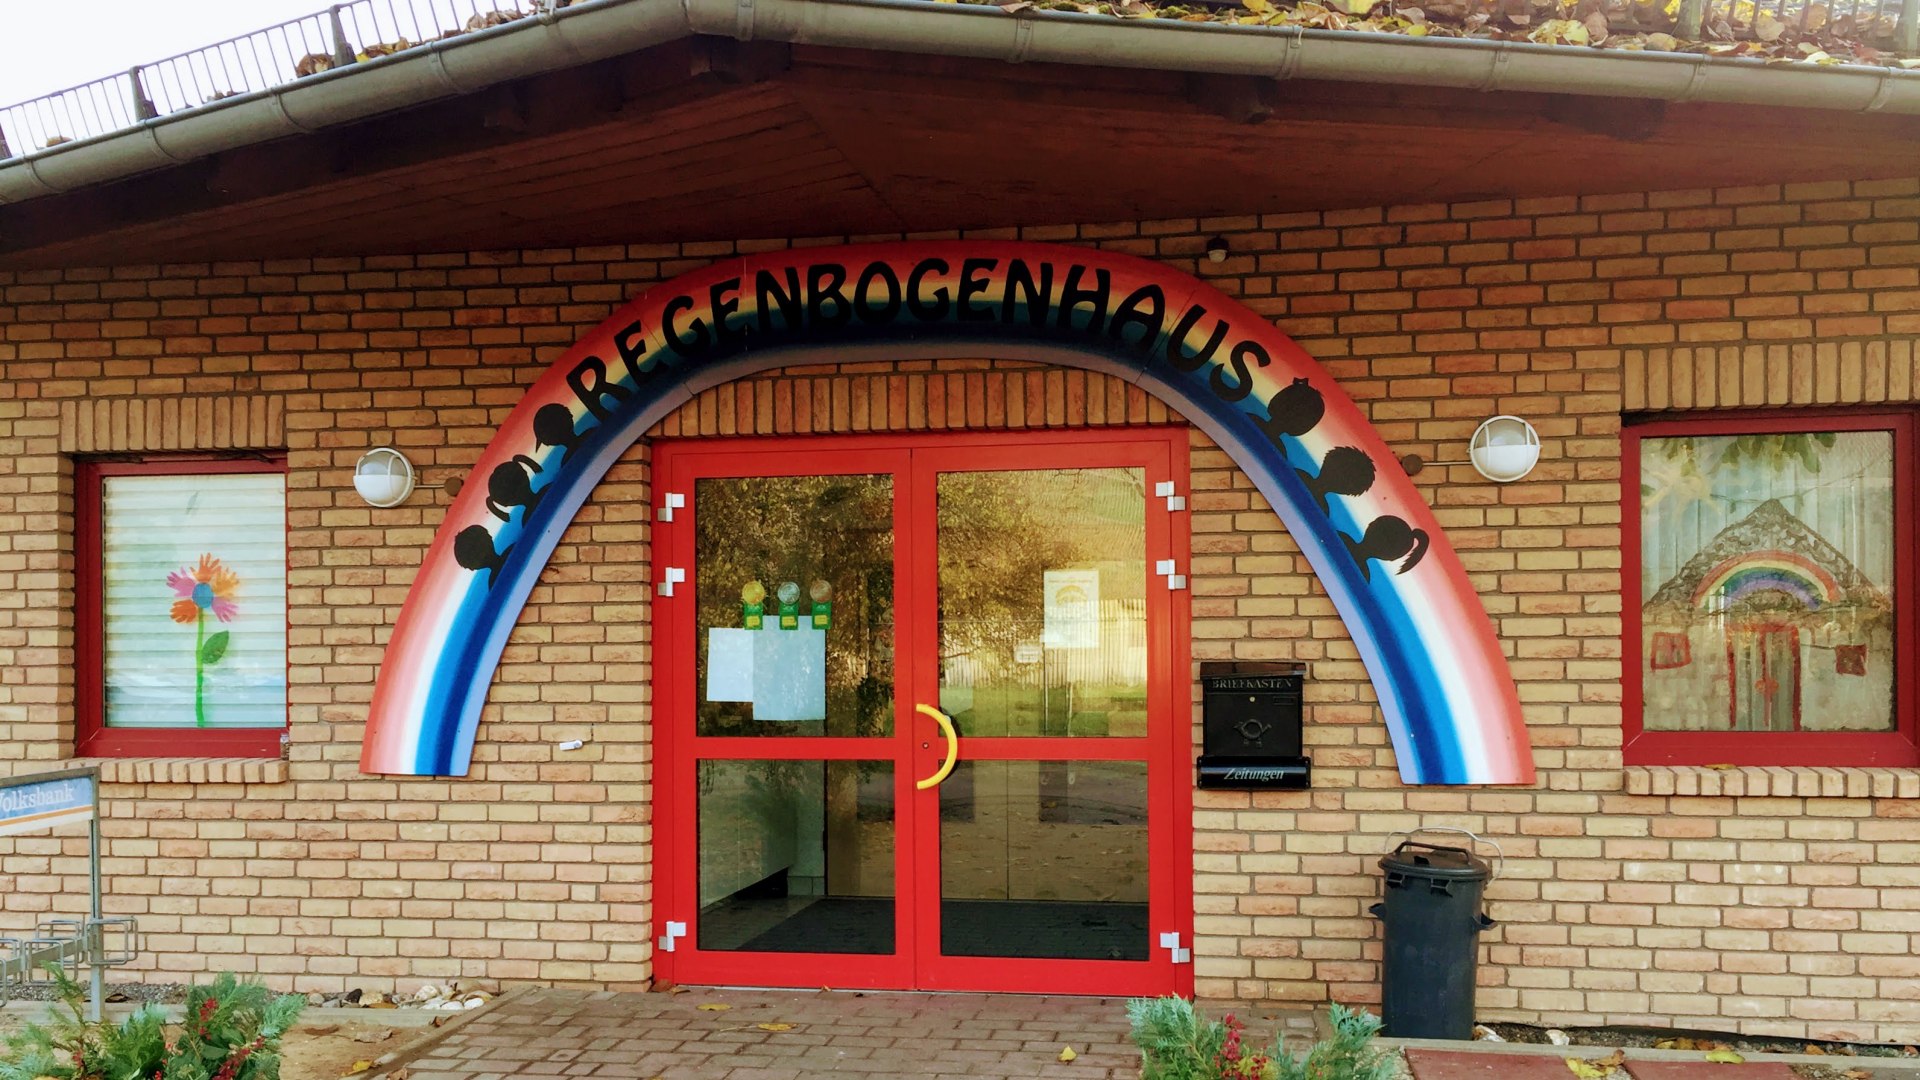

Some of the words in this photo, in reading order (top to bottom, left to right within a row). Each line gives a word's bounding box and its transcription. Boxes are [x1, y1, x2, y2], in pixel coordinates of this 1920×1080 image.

[566, 257, 1271, 423] REGENBOGENHAUS
[1212, 678, 1292, 689] BRIEFKASTEN
[1223, 767, 1285, 782] Zeitungen
